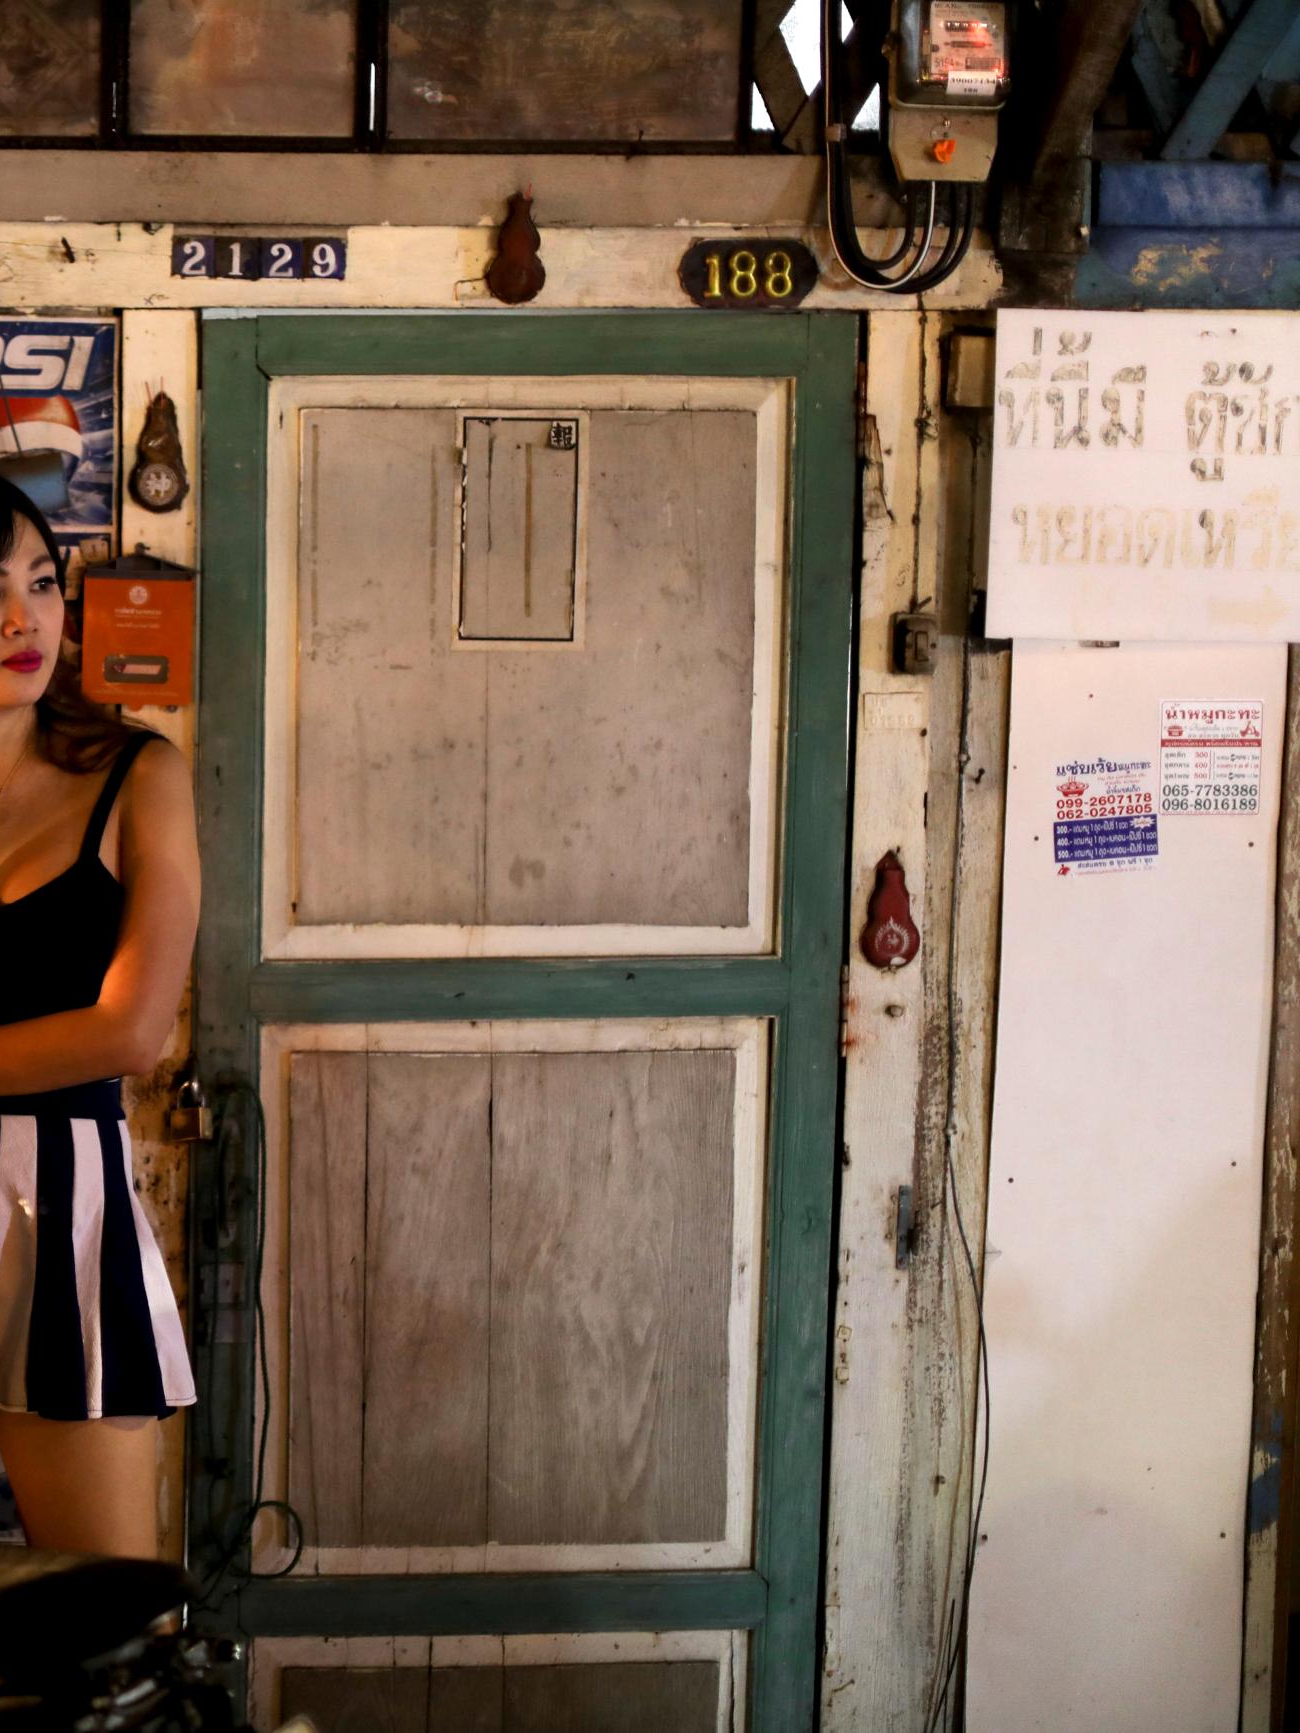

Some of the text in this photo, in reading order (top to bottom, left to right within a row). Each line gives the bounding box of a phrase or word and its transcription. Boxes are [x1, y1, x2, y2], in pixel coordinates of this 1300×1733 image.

[181, 238, 337, 278] 2129
[702, 249, 794, 299] 188
[1162, 784, 1258, 797] 065-7783386
[1056, 792, 1152, 809] 099-2607178
[1162, 798, 1257, 811] 096-8016189
[1056, 804, 1153, 820] 062-0247805
